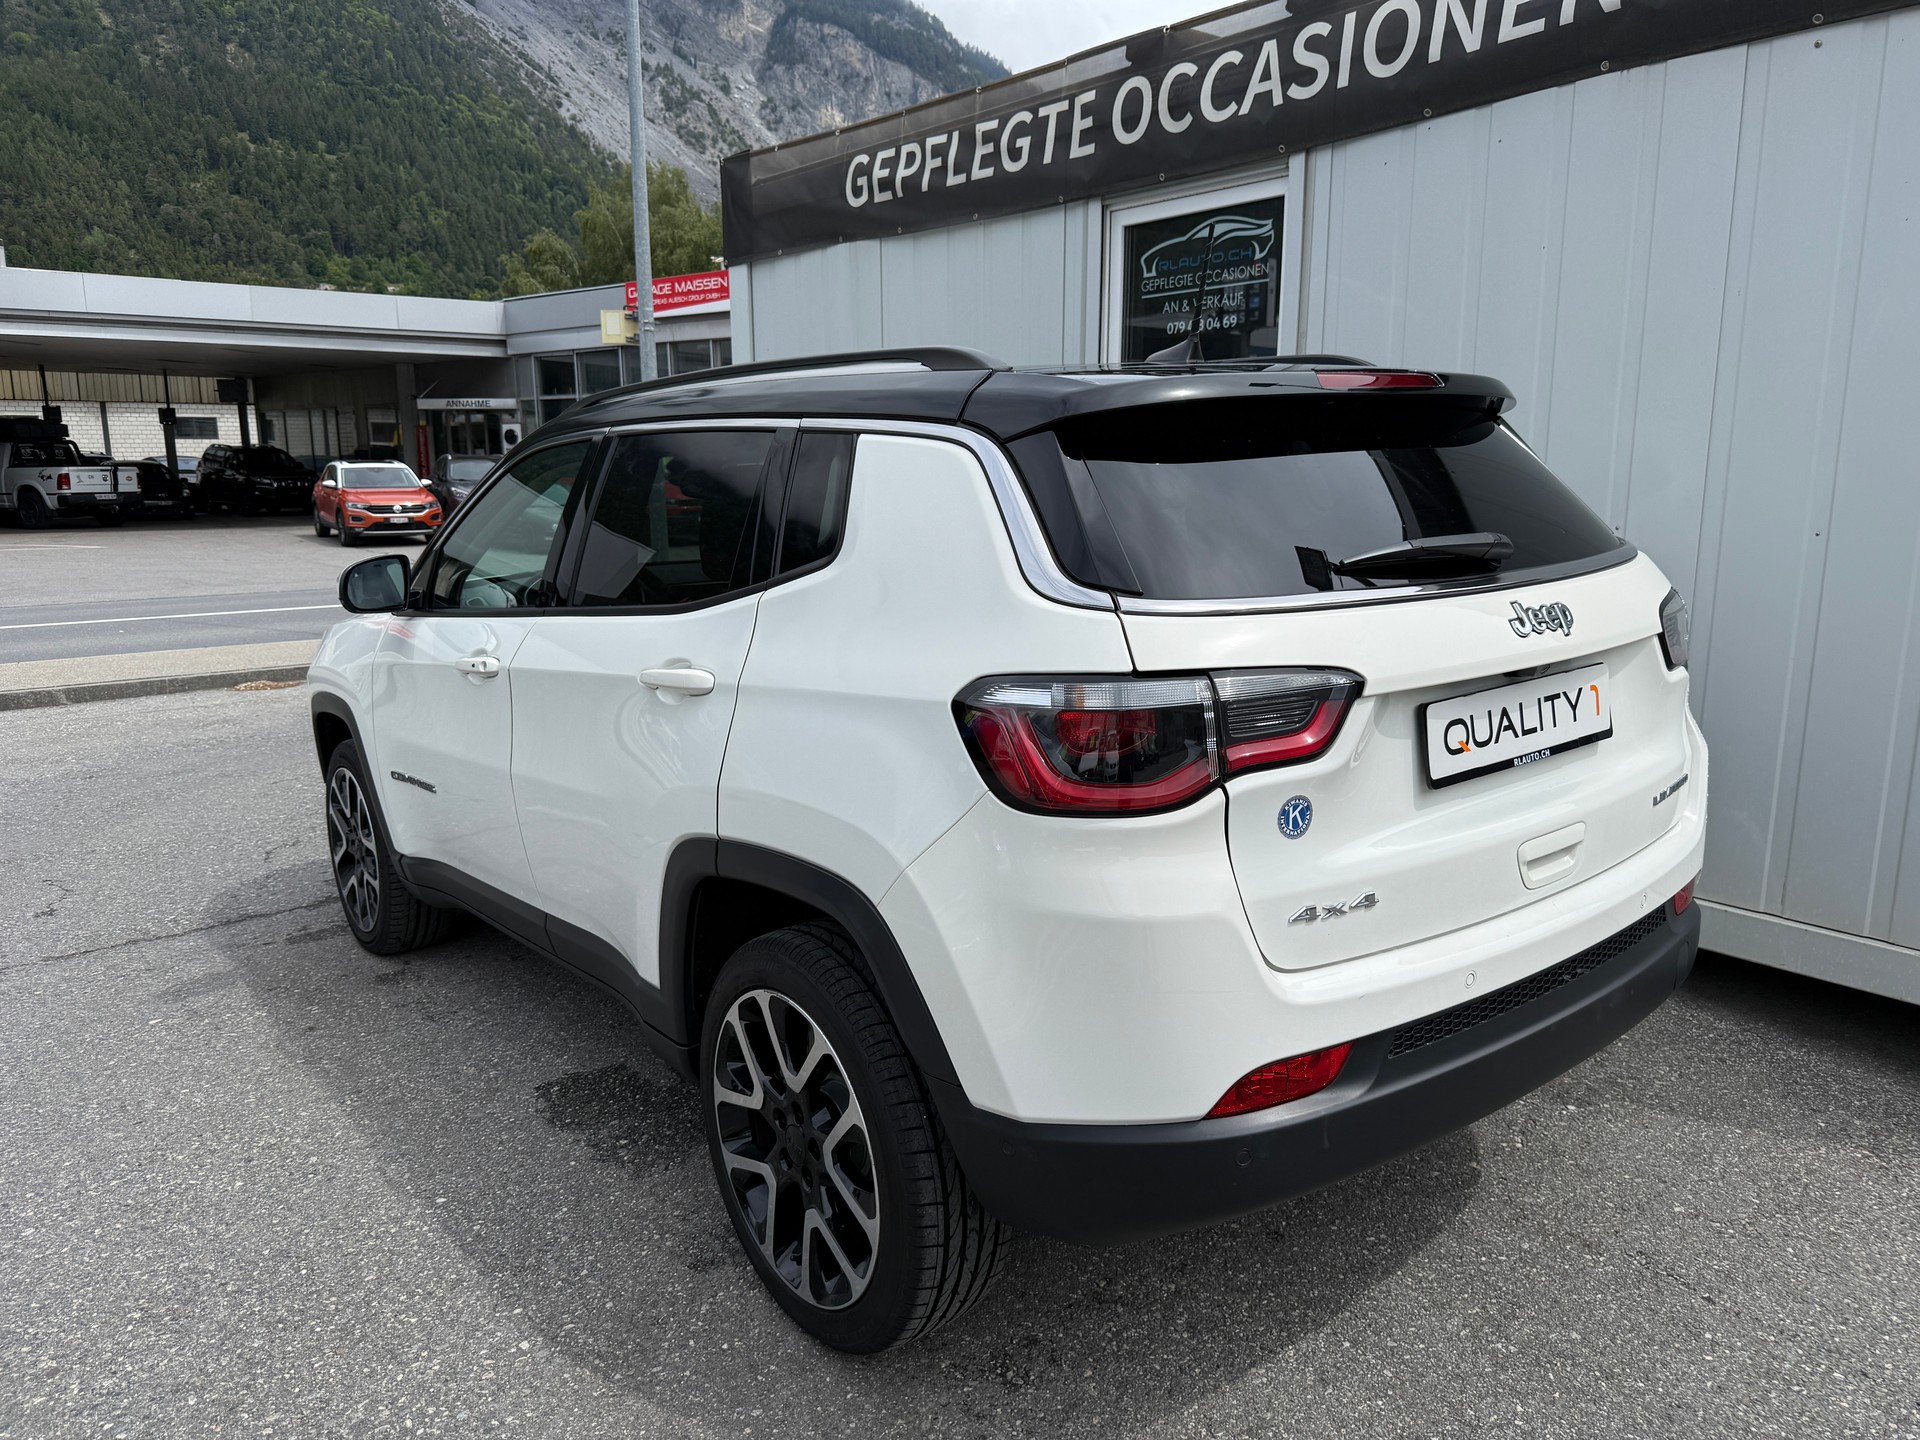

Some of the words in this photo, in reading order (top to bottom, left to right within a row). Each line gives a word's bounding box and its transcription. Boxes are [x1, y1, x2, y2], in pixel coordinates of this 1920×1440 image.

[845, 89, 1097, 208] GEPFLEGTE
[1112, 0, 1622, 145] OCCASIONE
[1158, 248, 1253, 272] RLAUO.CH
[628, 284, 672, 298] GAGE
[674, 276, 728, 293] MAISSEN
[1141, 273, 1193, 292] GEPFLEGTE
[1162, 300, 1179, 314] AN
[1181, 299, 1190, 313] &
[1166, 320, 1186, 335] 079
[1187, 318, 1205, 331] 43
[1206, 317, 1221, 331] 04
[1222, 315, 1238, 329] 69
[446, 399, 491, 408] ANNAHME
[1508, 600, 1574, 638] Jeep
[1443, 687, 1583, 756] QUALITY
[1589, 684, 1600, 716] 1
[1513, 749, 1551, 767] RLAUTO.CH
[1284, 799, 1308, 811] KIWANIS
[1289, 804, 1304, 831] K
